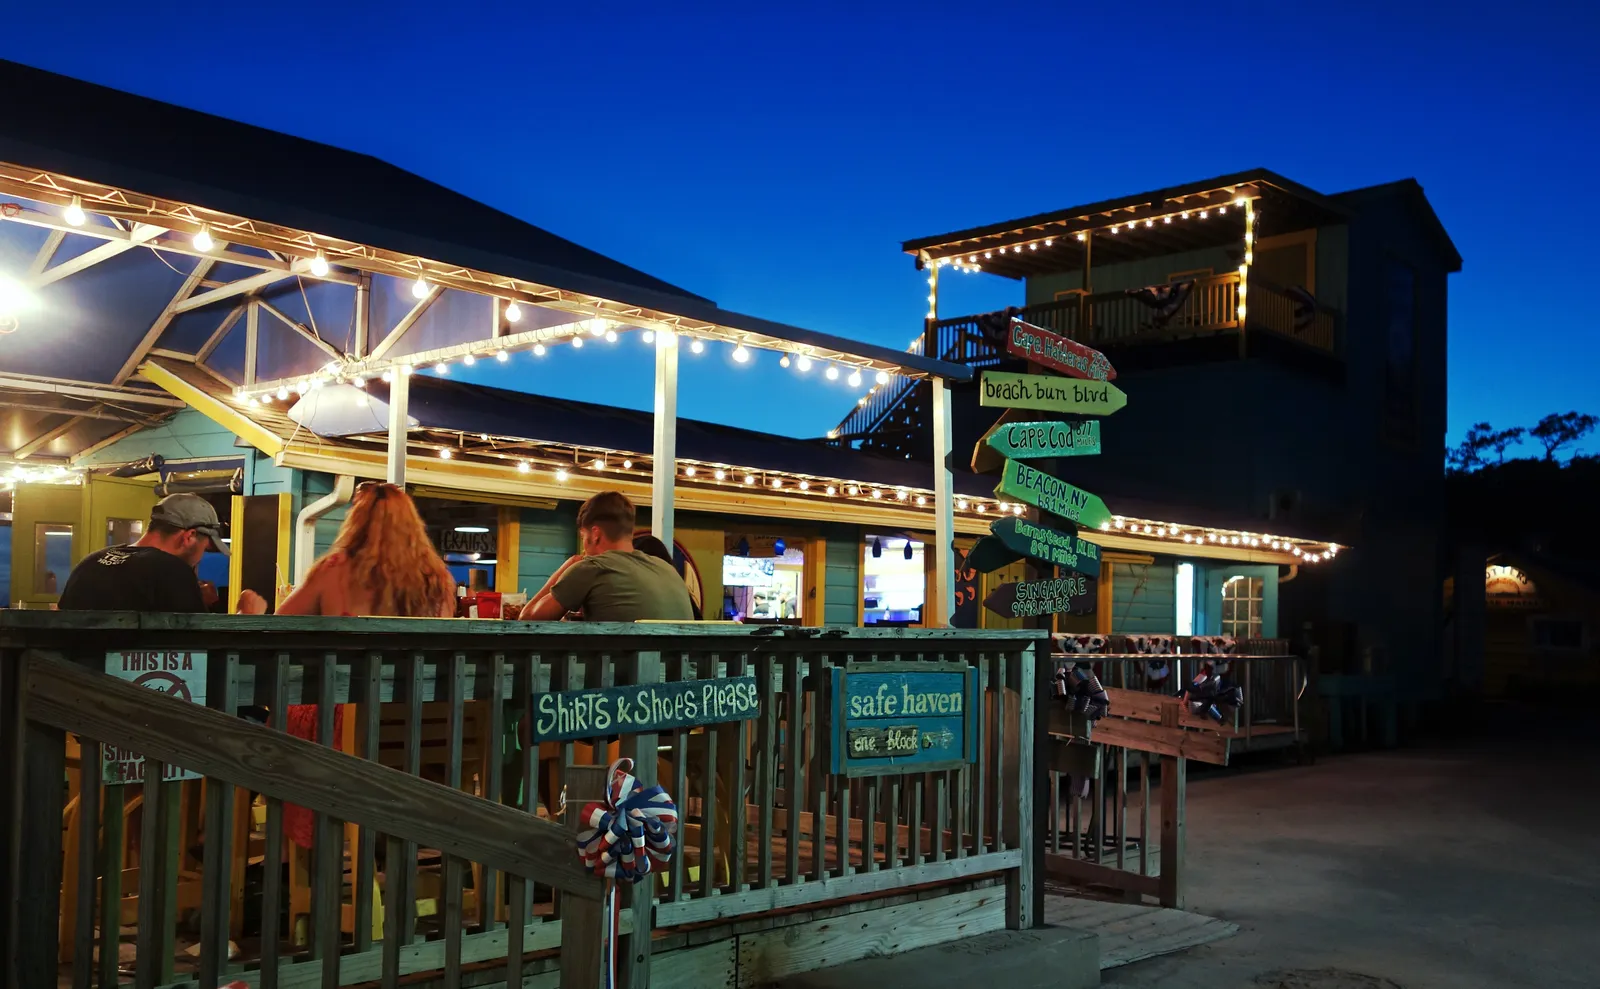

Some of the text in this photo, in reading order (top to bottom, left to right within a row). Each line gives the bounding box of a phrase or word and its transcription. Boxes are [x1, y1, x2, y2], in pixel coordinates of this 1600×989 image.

[1013, 325, 1089, 372] Cape Hatteras
[983, 377, 1109, 402] beach bum blvd
[1008, 425, 1074, 449] Cape Cod
[1070, 488, 1089, 509] NY
[1058, 502, 1080, 521] Miles
[1030, 540, 1078, 567] 899 Miles
[1016, 577, 1087, 601] SINGAPORE
[1012, 597, 1069, 617] 9948 MILES
[120, 652, 193, 671] THIS IS A
[617, 695, 632, 724] &
[634, 688, 699, 725] Shoes
[702, 682, 759, 718] Please
[850, 683, 962, 718] safe haven
[886, 729, 918, 751] block
